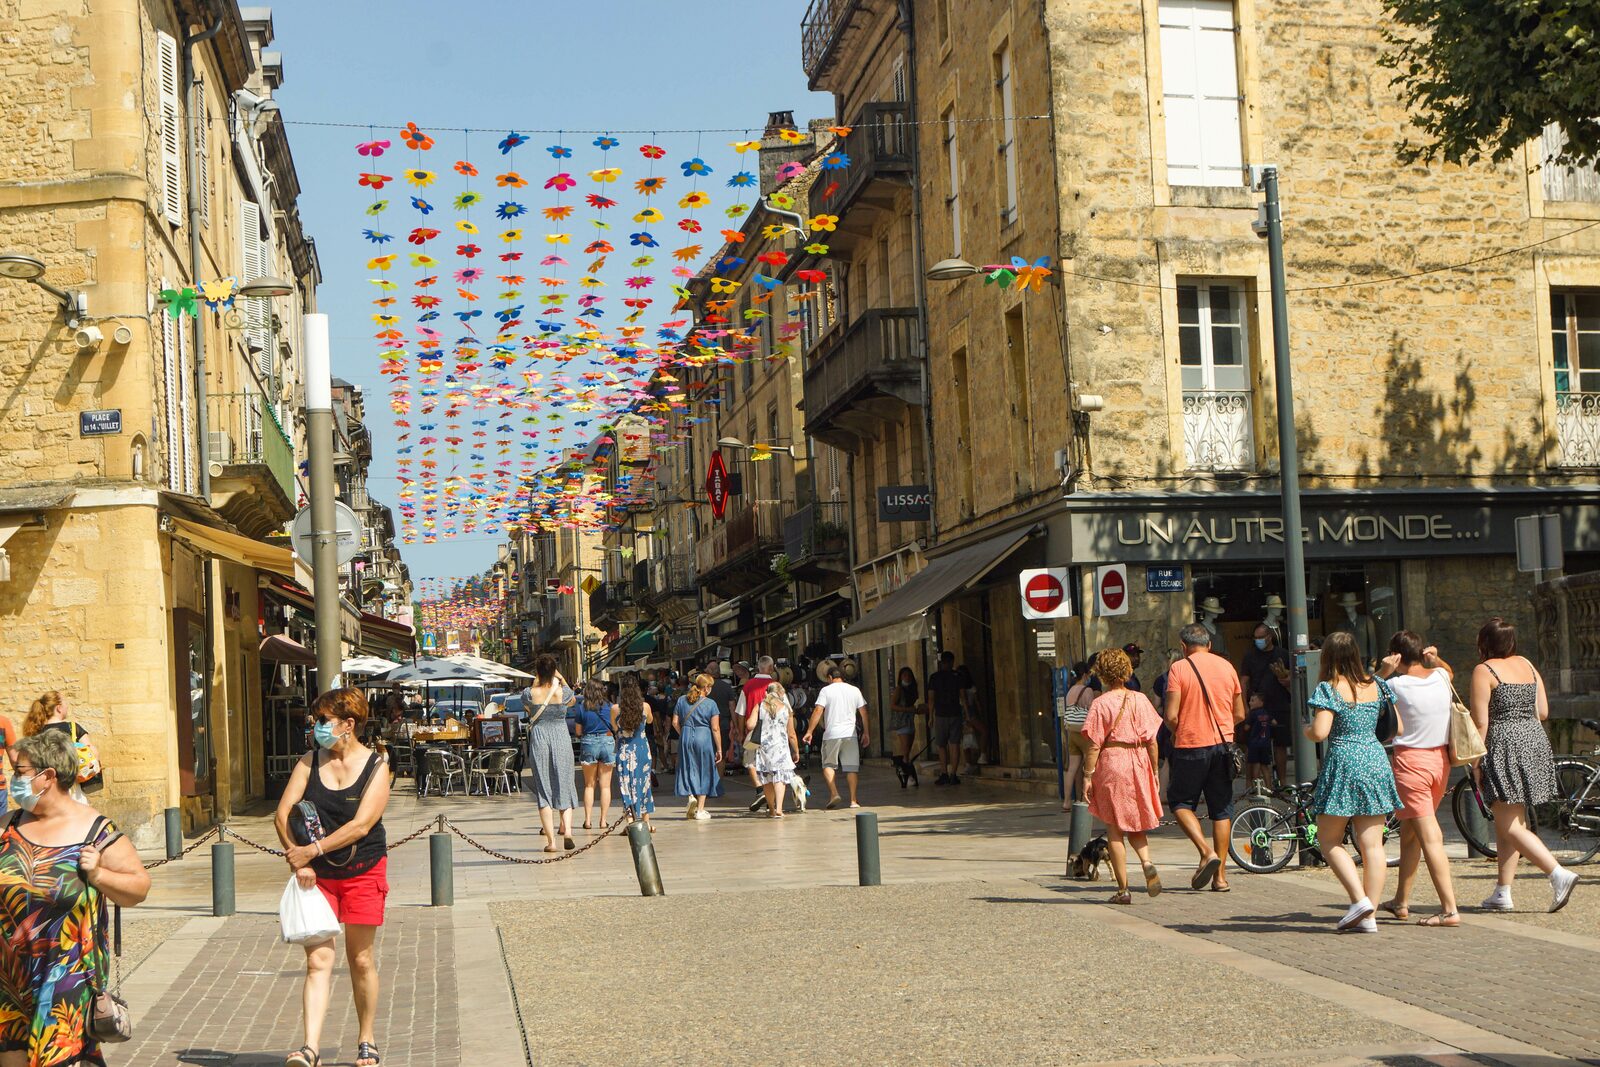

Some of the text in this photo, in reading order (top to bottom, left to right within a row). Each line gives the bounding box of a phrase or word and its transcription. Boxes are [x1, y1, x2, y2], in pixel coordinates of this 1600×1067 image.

[887, 494, 930, 506] LISSAC
[1117, 518, 1174, 545] UN
[1161, 580, 1182, 588] ESCANDE
